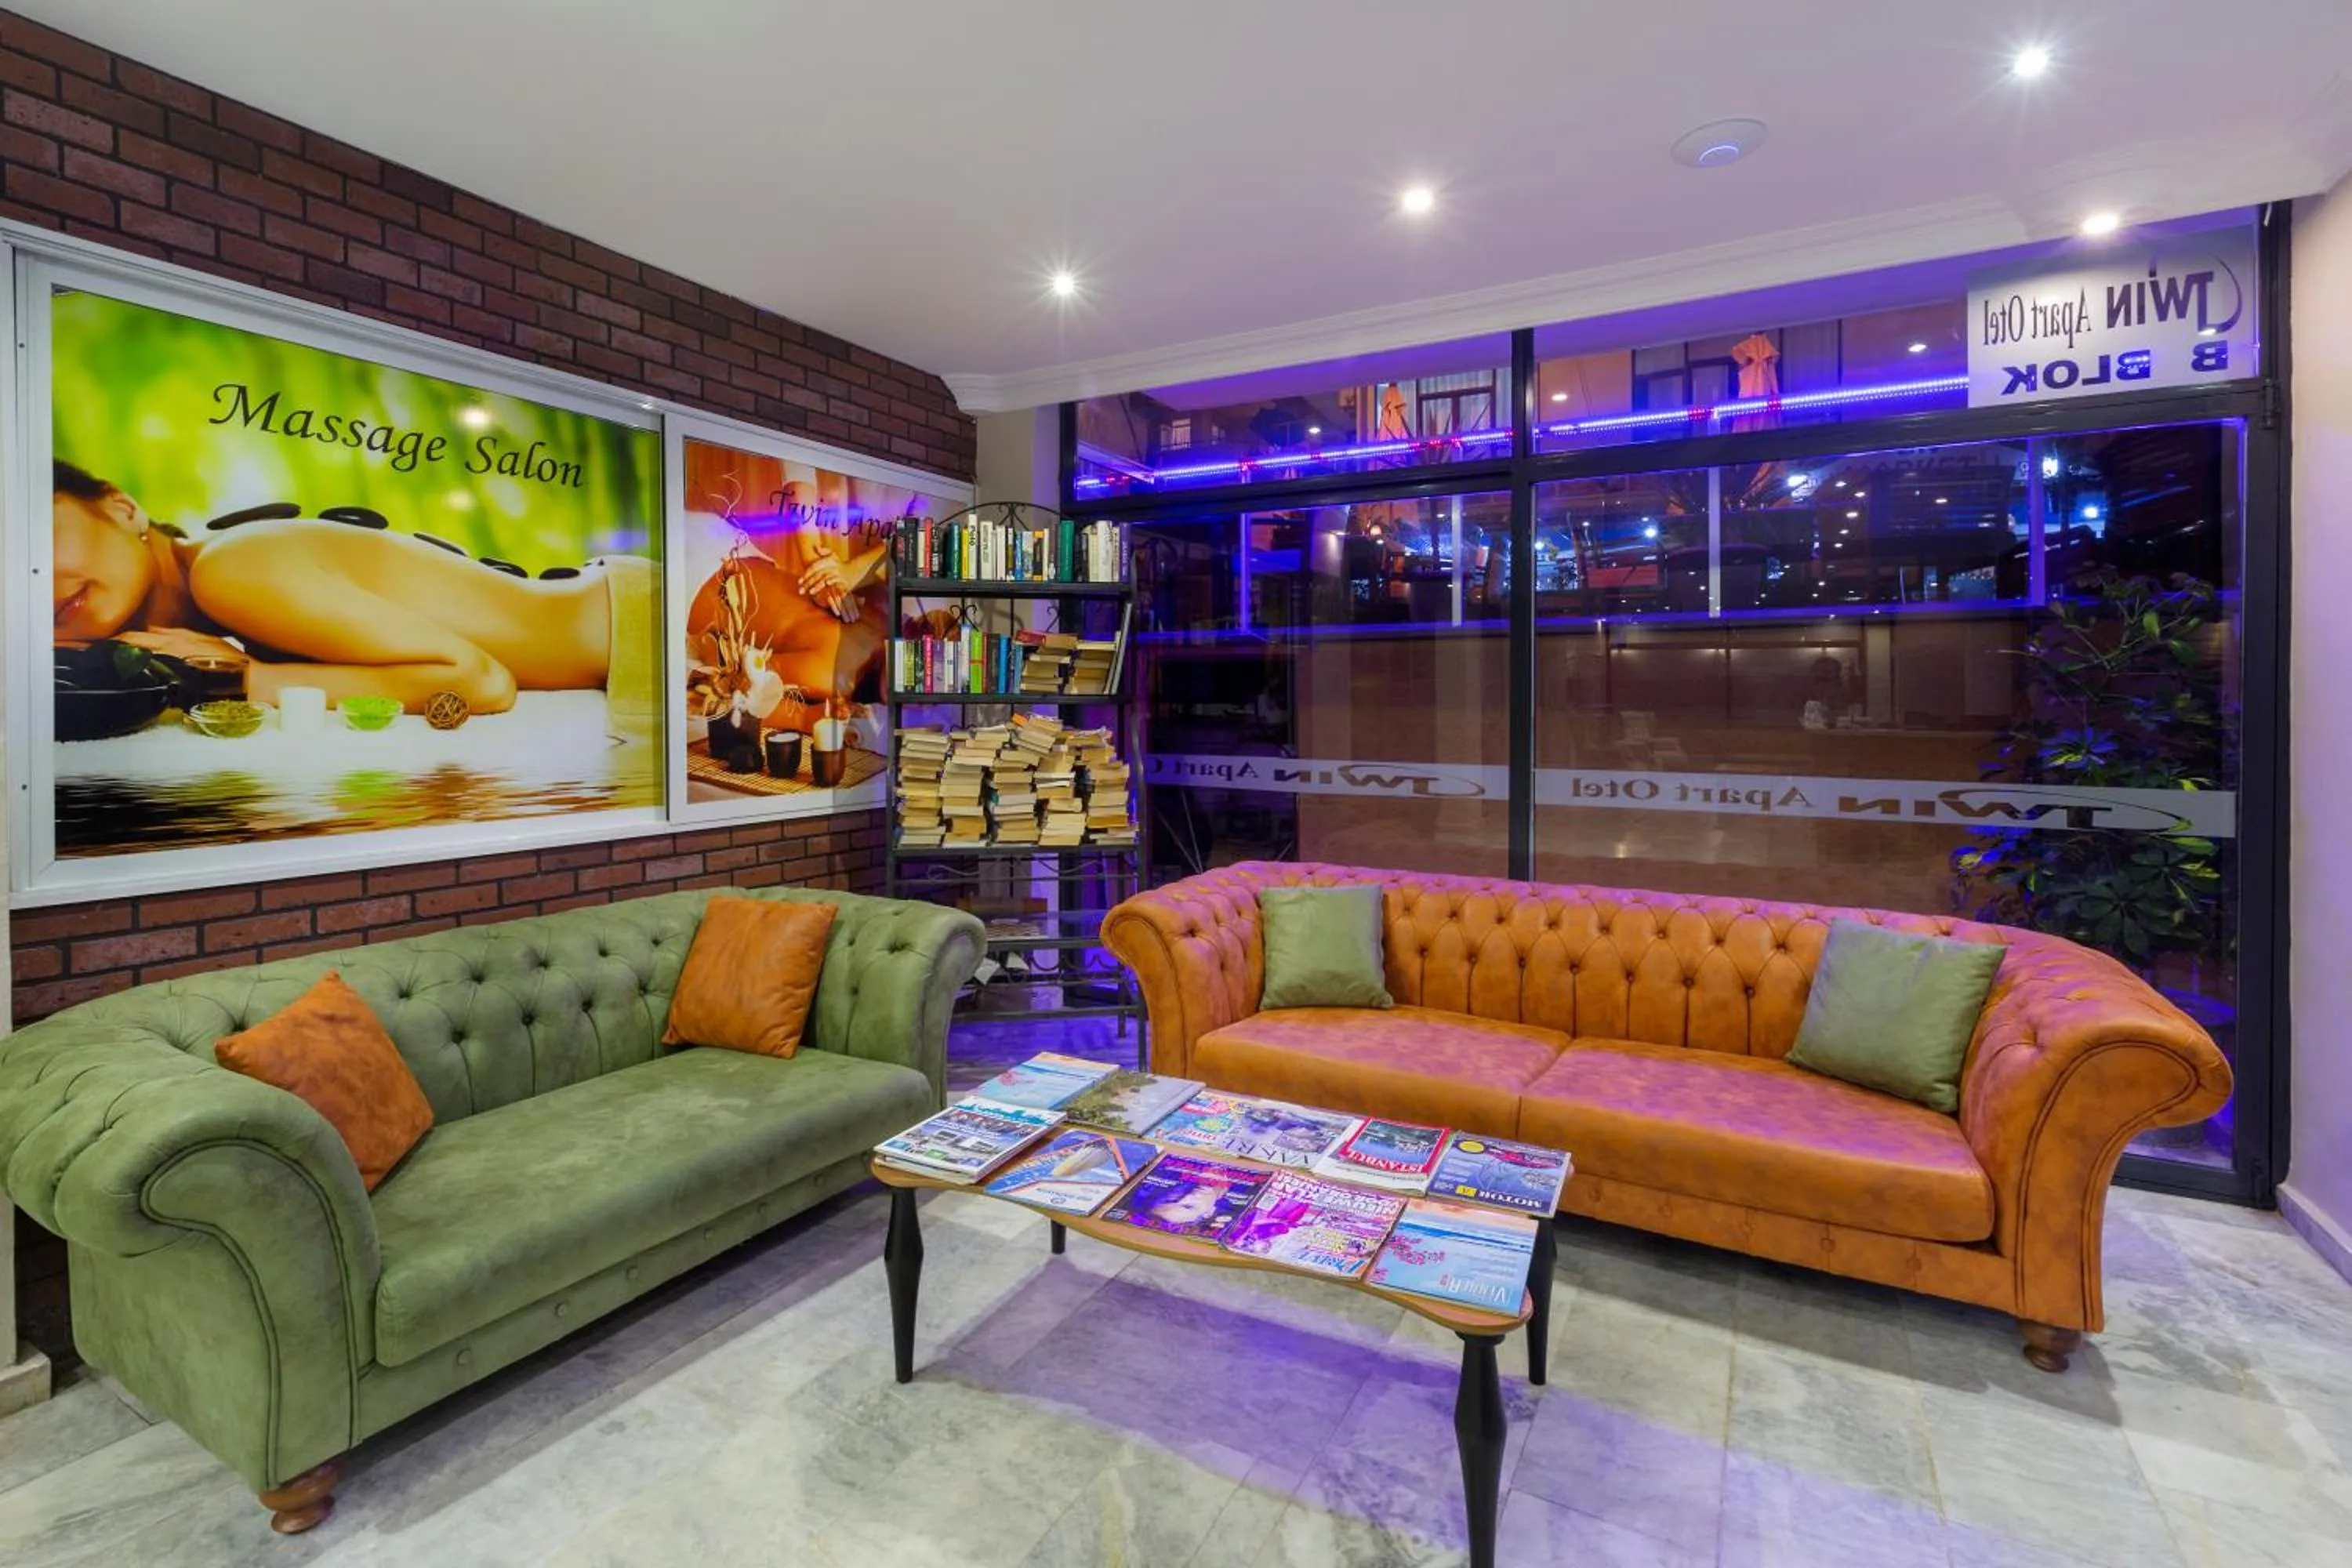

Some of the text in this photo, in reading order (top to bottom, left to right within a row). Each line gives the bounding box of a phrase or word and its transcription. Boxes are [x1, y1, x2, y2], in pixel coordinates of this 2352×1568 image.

[208, 383, 586, 488] Massage Salon
[842, 508, 902, 546] Apa
[1478, 1190, 1542, 1208] MOTOR
